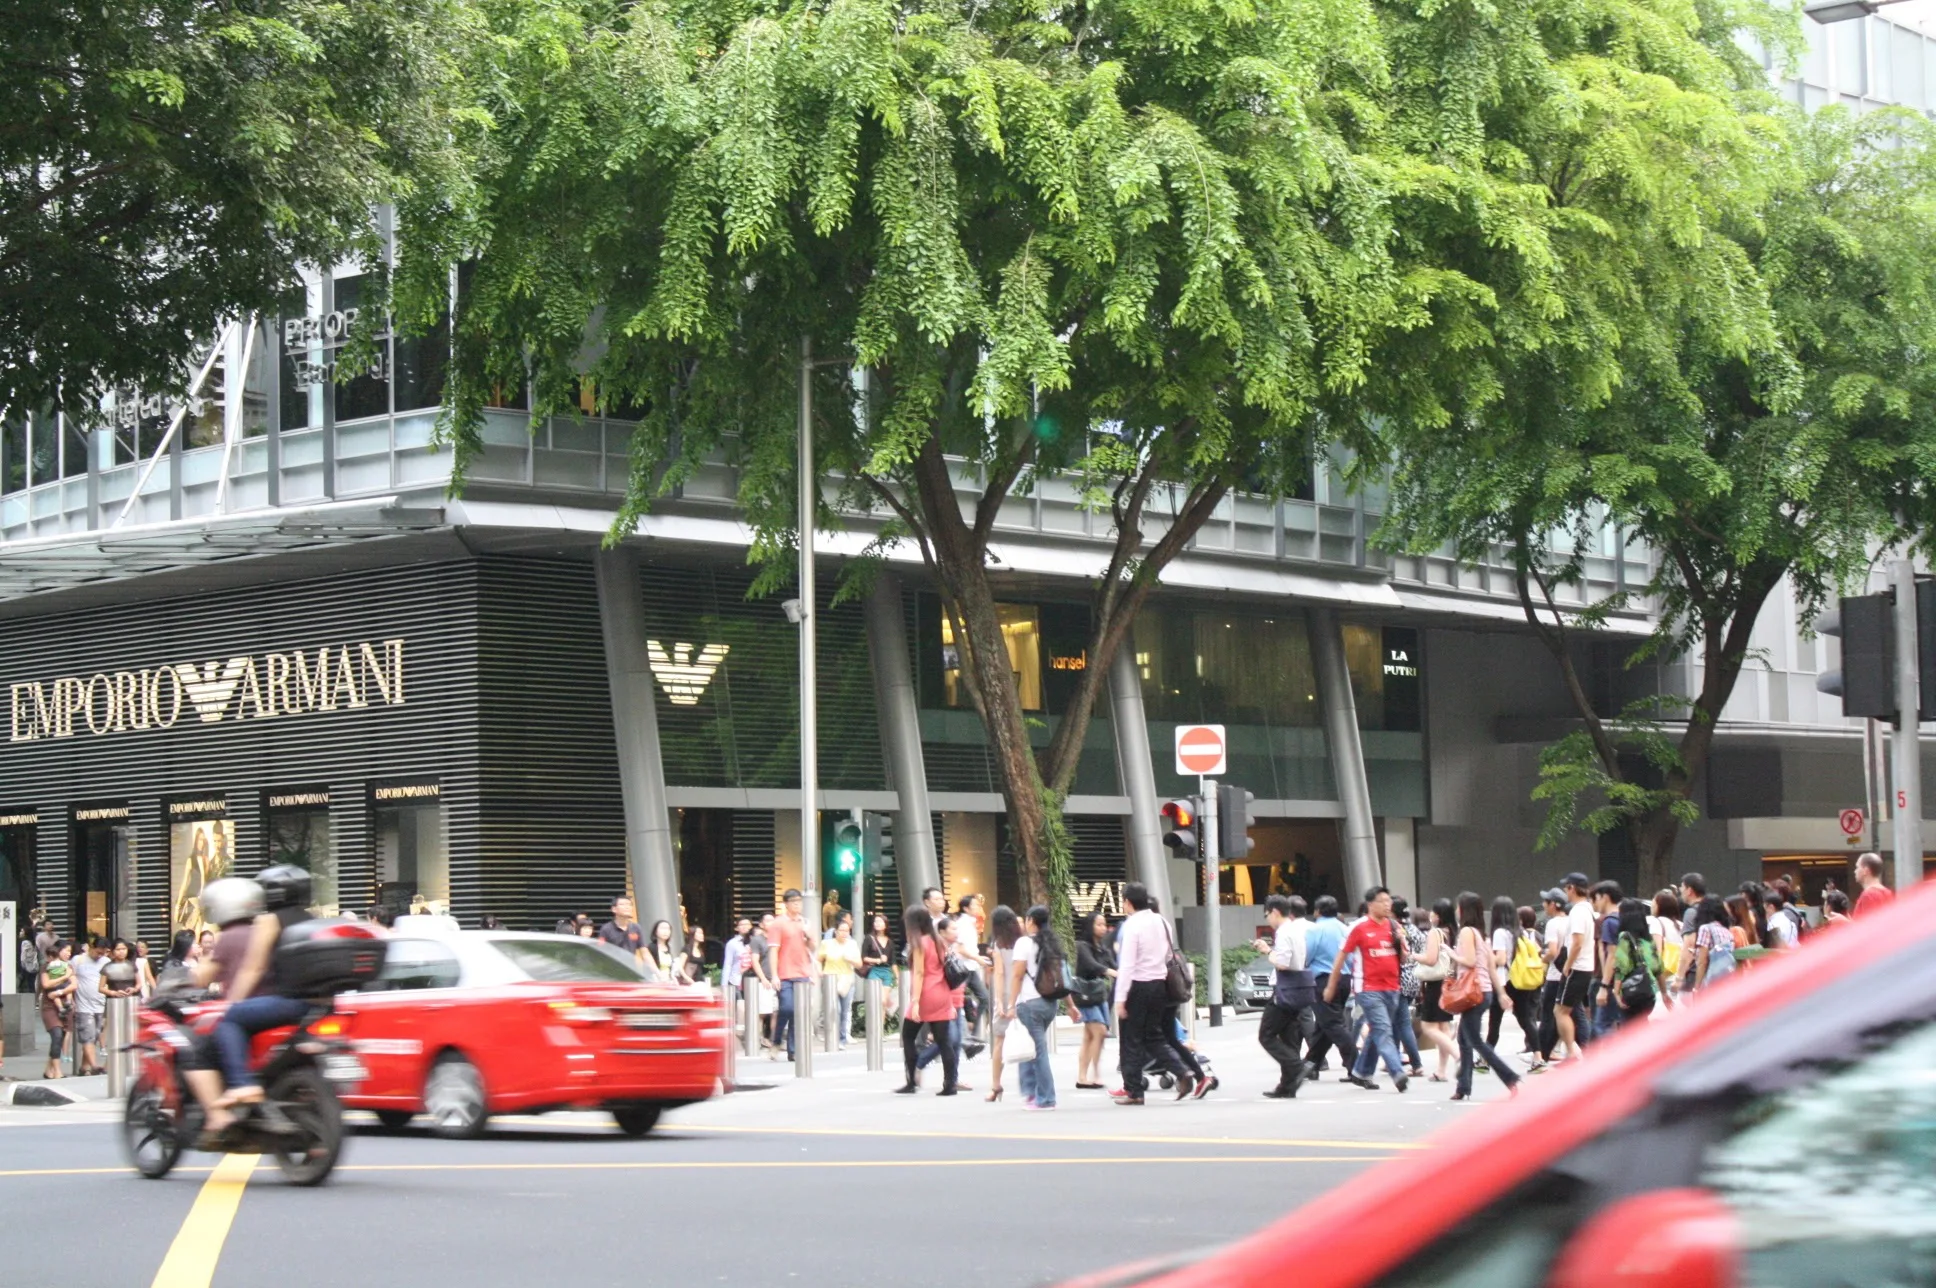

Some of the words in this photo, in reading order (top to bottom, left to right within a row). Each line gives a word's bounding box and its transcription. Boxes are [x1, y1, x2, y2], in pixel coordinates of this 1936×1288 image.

[1048, 648, 1087, 670] hansel
[1390, 650, 1409, 662] LA
[1383, 664, 1417, 677] PUTRI
[10, 665, 182, 742] EMPORIO
[236, 638, 405, 720] ARMANI
[376, 787, 405, 799] EMPORIO
[413, 784, 439, 797] ARMANI
[1897, 790, 1906, 808] 5
[270, 794, 297, 807] EMPORIO
[303, 793, 329, 804] ARMANI
